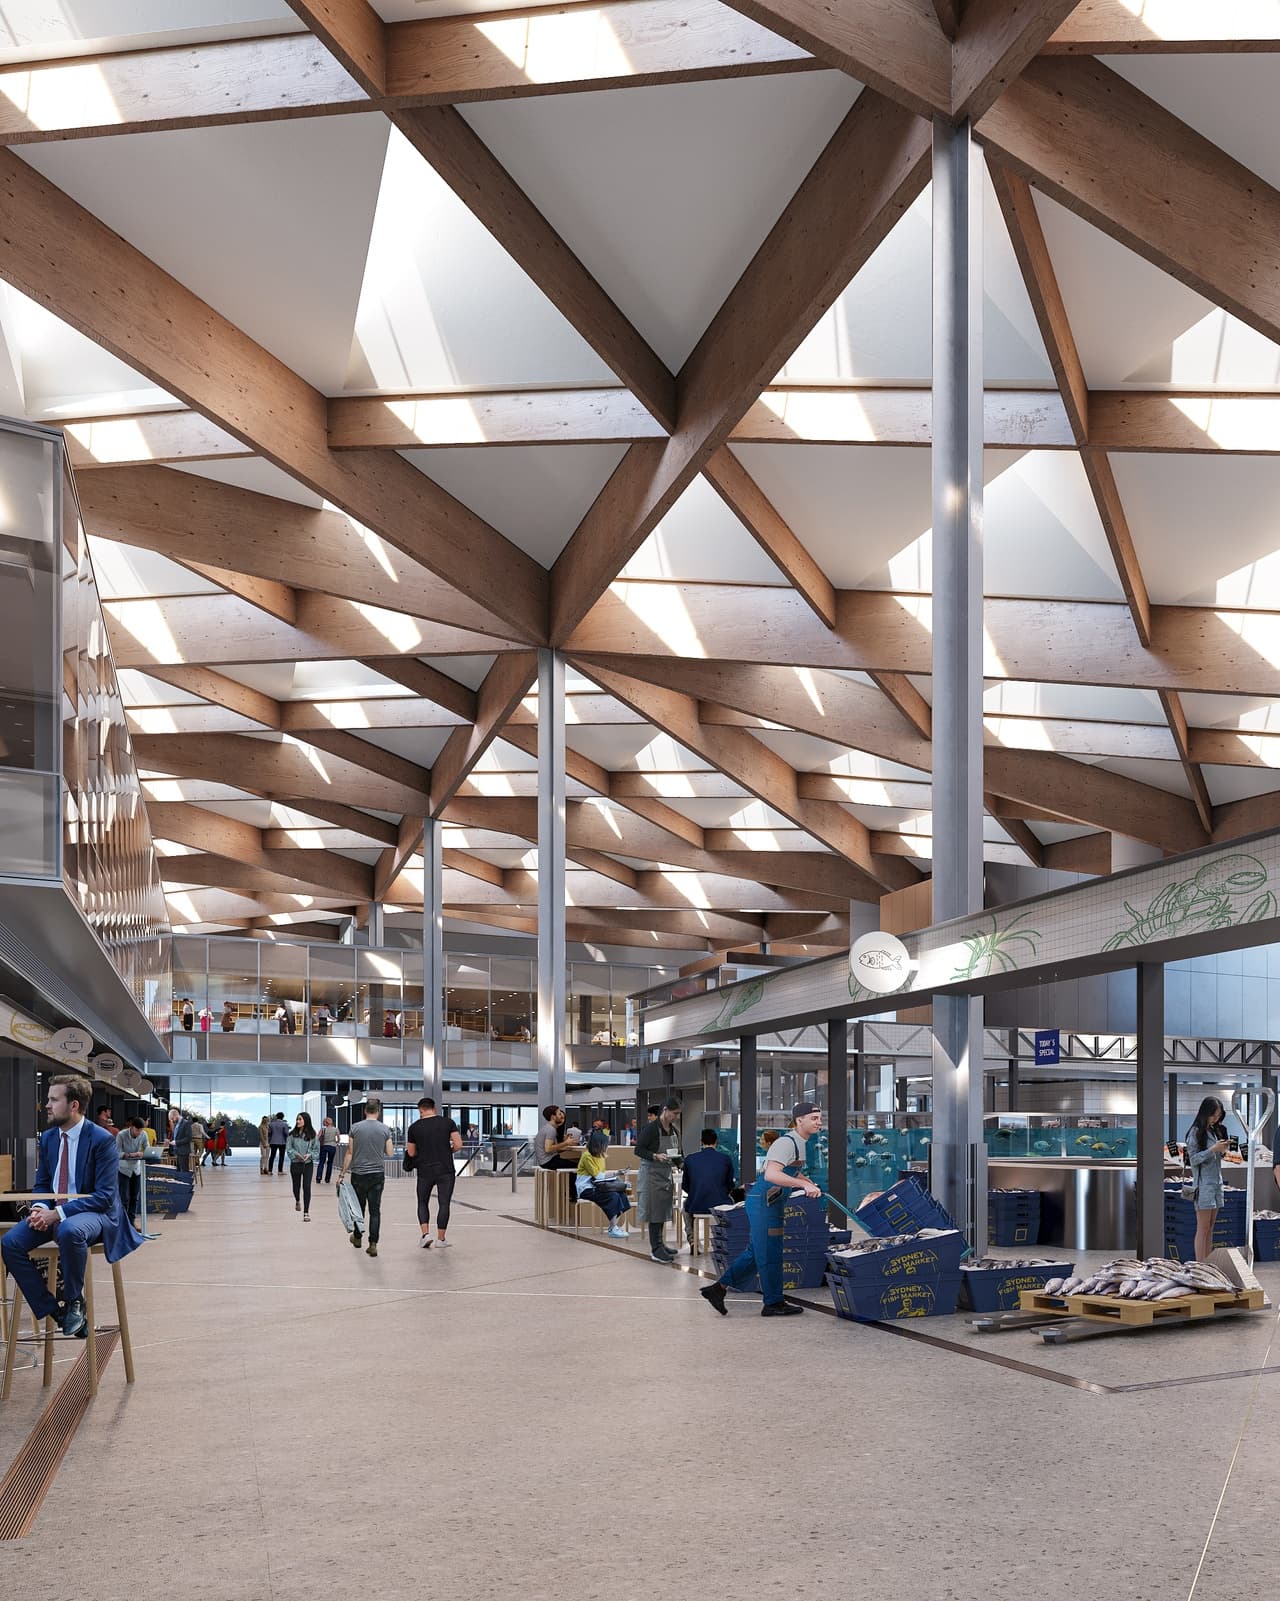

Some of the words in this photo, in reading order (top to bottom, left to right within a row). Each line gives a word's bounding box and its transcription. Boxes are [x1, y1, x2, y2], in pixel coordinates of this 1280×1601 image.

[890, 1251, 924, 1267] SYDNEY
[903, 1257, 935, 1269] MARKET
[1006, 1276, 1036, 1286] SYDNEY
[890, 1286, 922, 1296] SYDNEY
